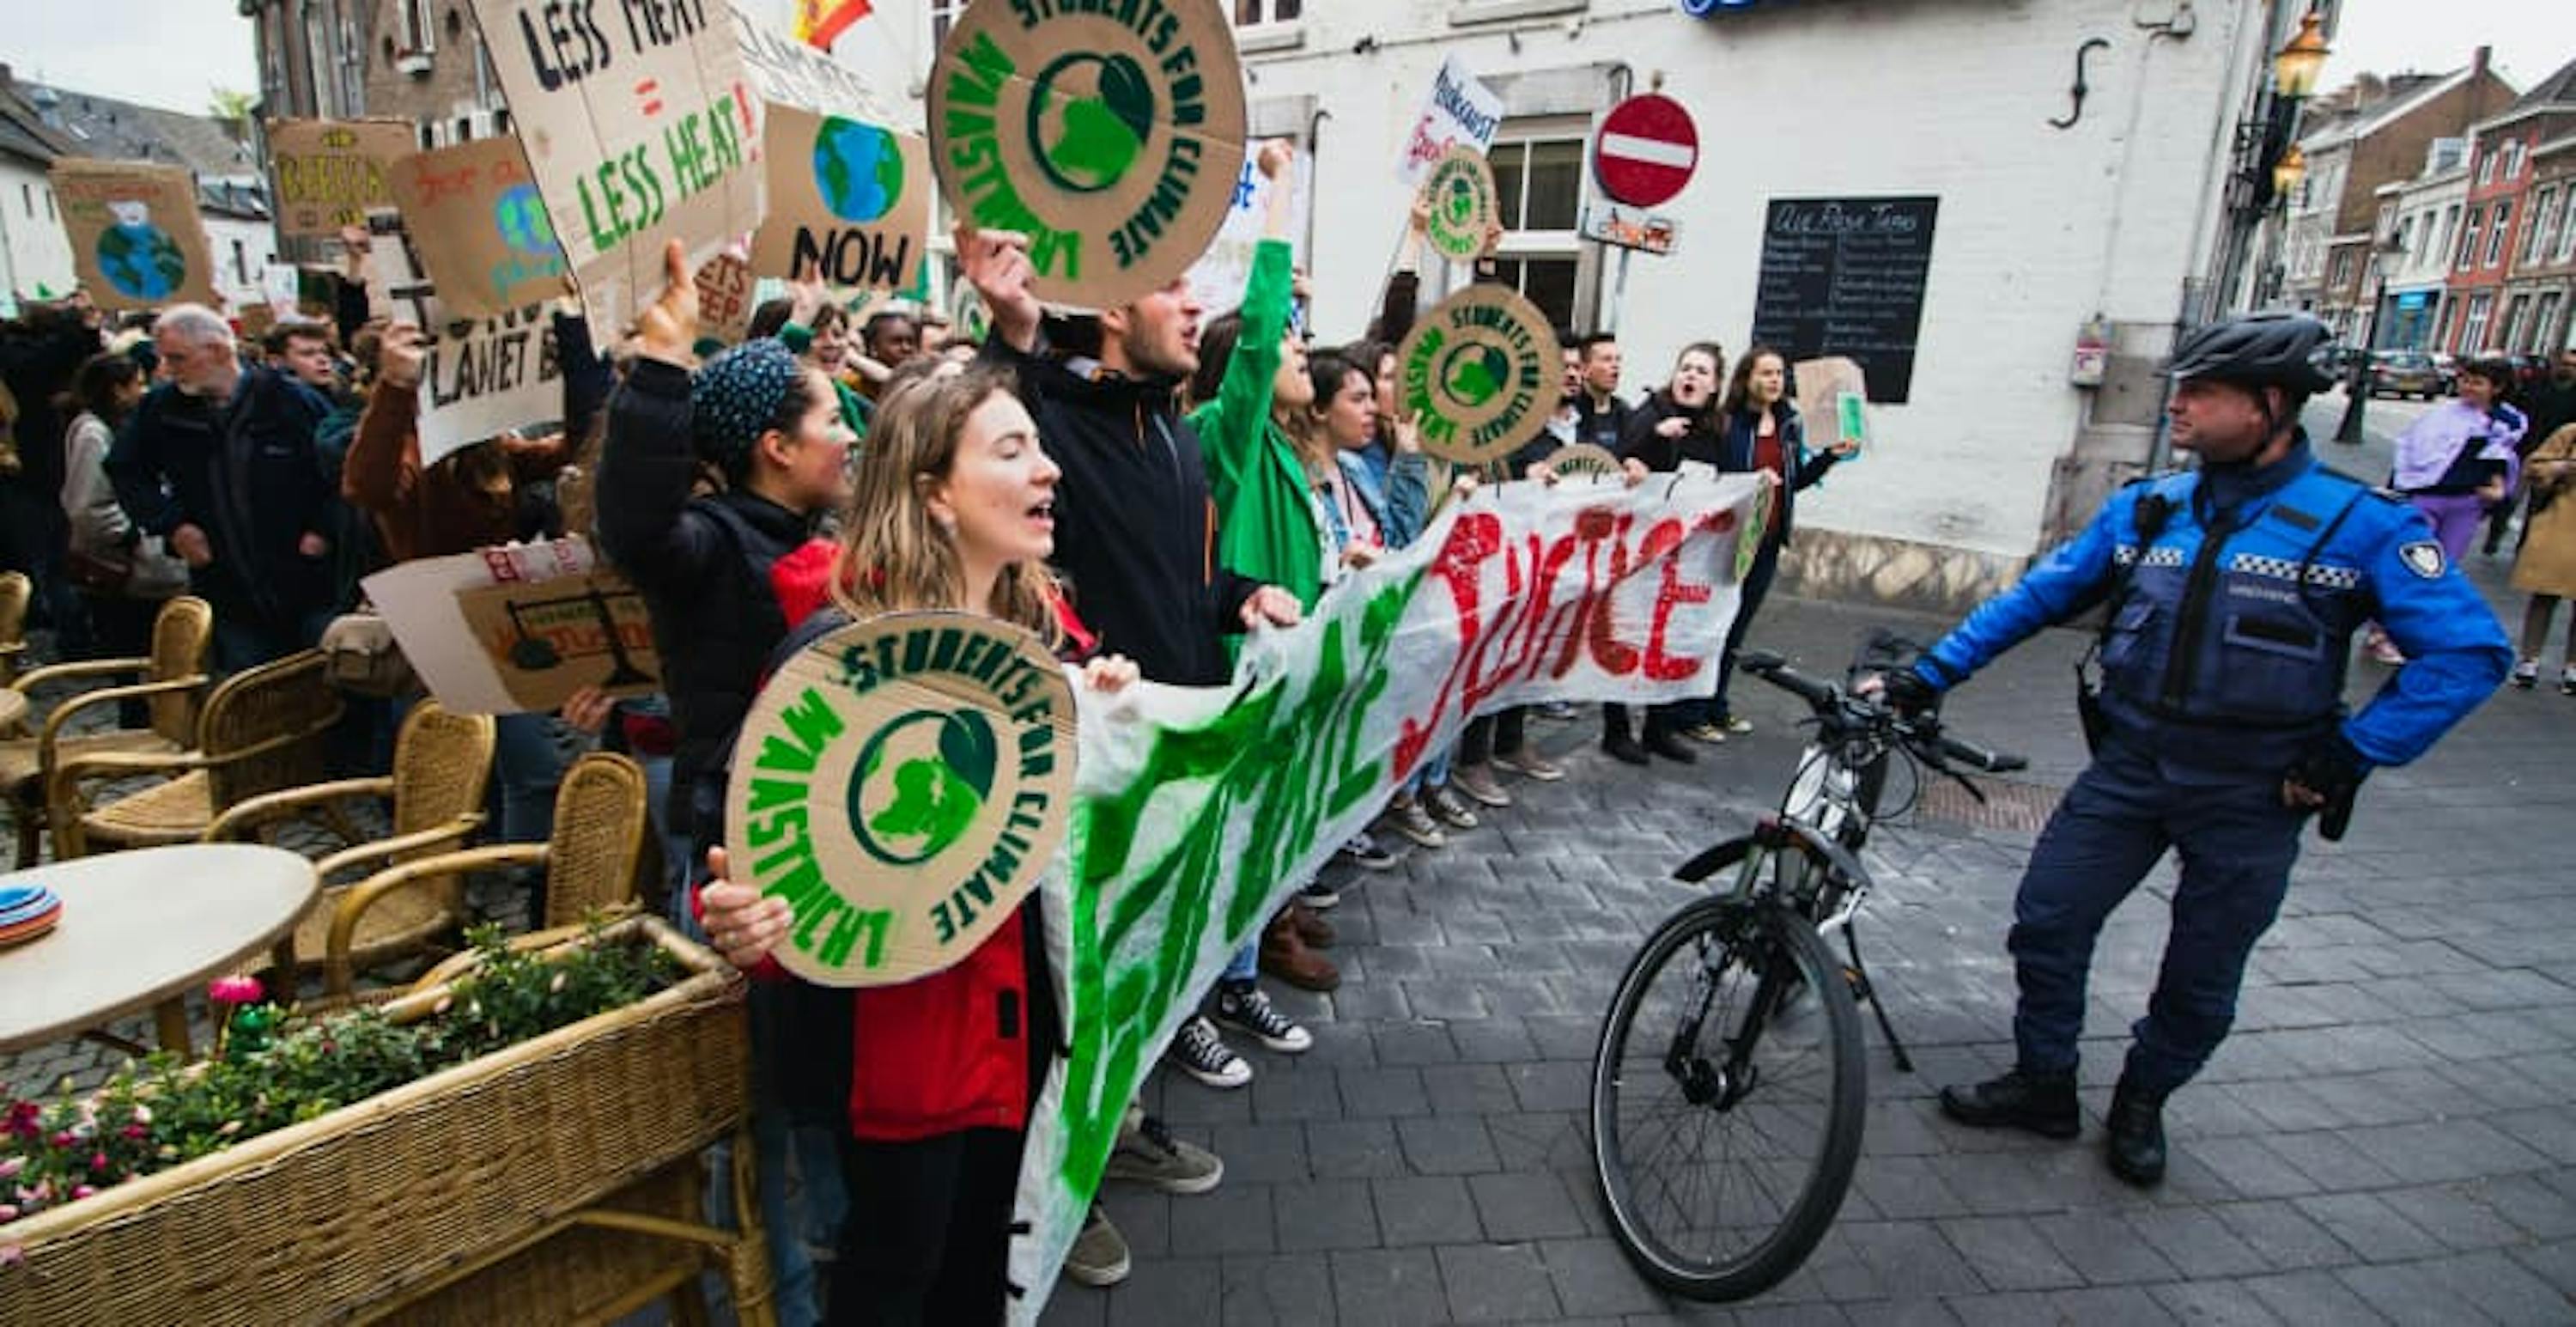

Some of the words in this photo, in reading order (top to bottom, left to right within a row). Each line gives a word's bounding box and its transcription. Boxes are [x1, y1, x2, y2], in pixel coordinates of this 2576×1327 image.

[519, 0, 611, 91] LESS
[1162, 46, 1206, 125] FOR
[576, 143, 664, 251] LESS
[946, 30, 1081, 280] MAASTRHT
[1108, 137, 1201, 269] CLIMATE
[793, 227, 908, 287] NOW
[422, 330, 530, 409] LANET
[839, 628, 1042, 707] STUDENTS
[1012, 698, 1056, 780] FOR
[928, 791, 1049, 946] CLIMATE
